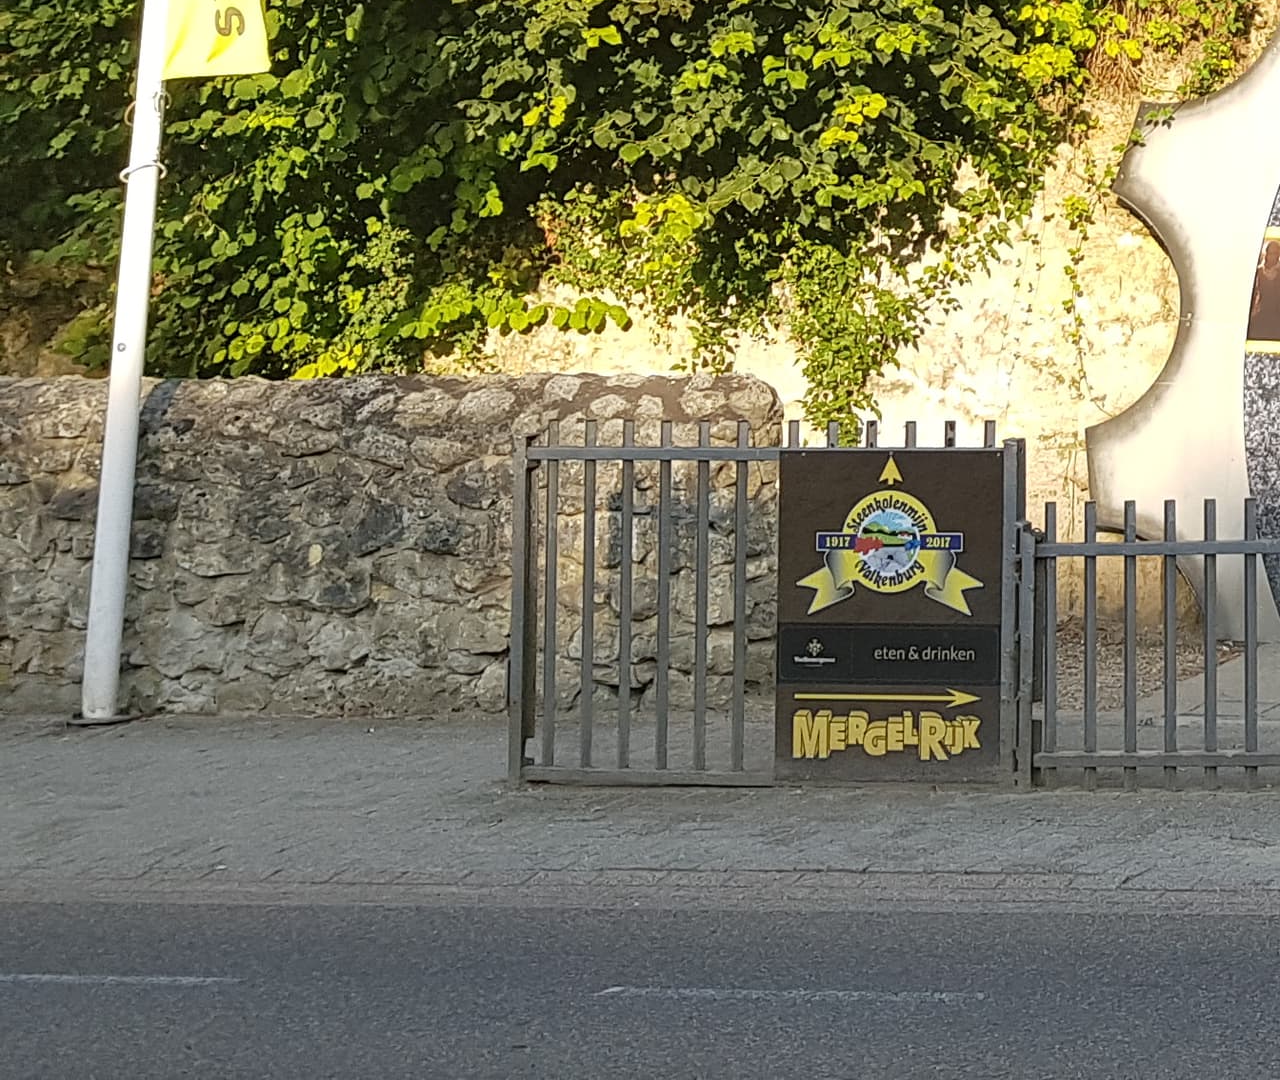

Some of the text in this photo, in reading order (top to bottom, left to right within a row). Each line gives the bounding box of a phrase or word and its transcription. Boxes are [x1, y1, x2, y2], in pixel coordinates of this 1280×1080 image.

[847, 495, 928, 533] Steenkolenmijn
[825, 536, 952, 549] 1917 2017
[855, 559, 925, 589] Valkenburg
[874, 646, 976, 661] eten & drinken
